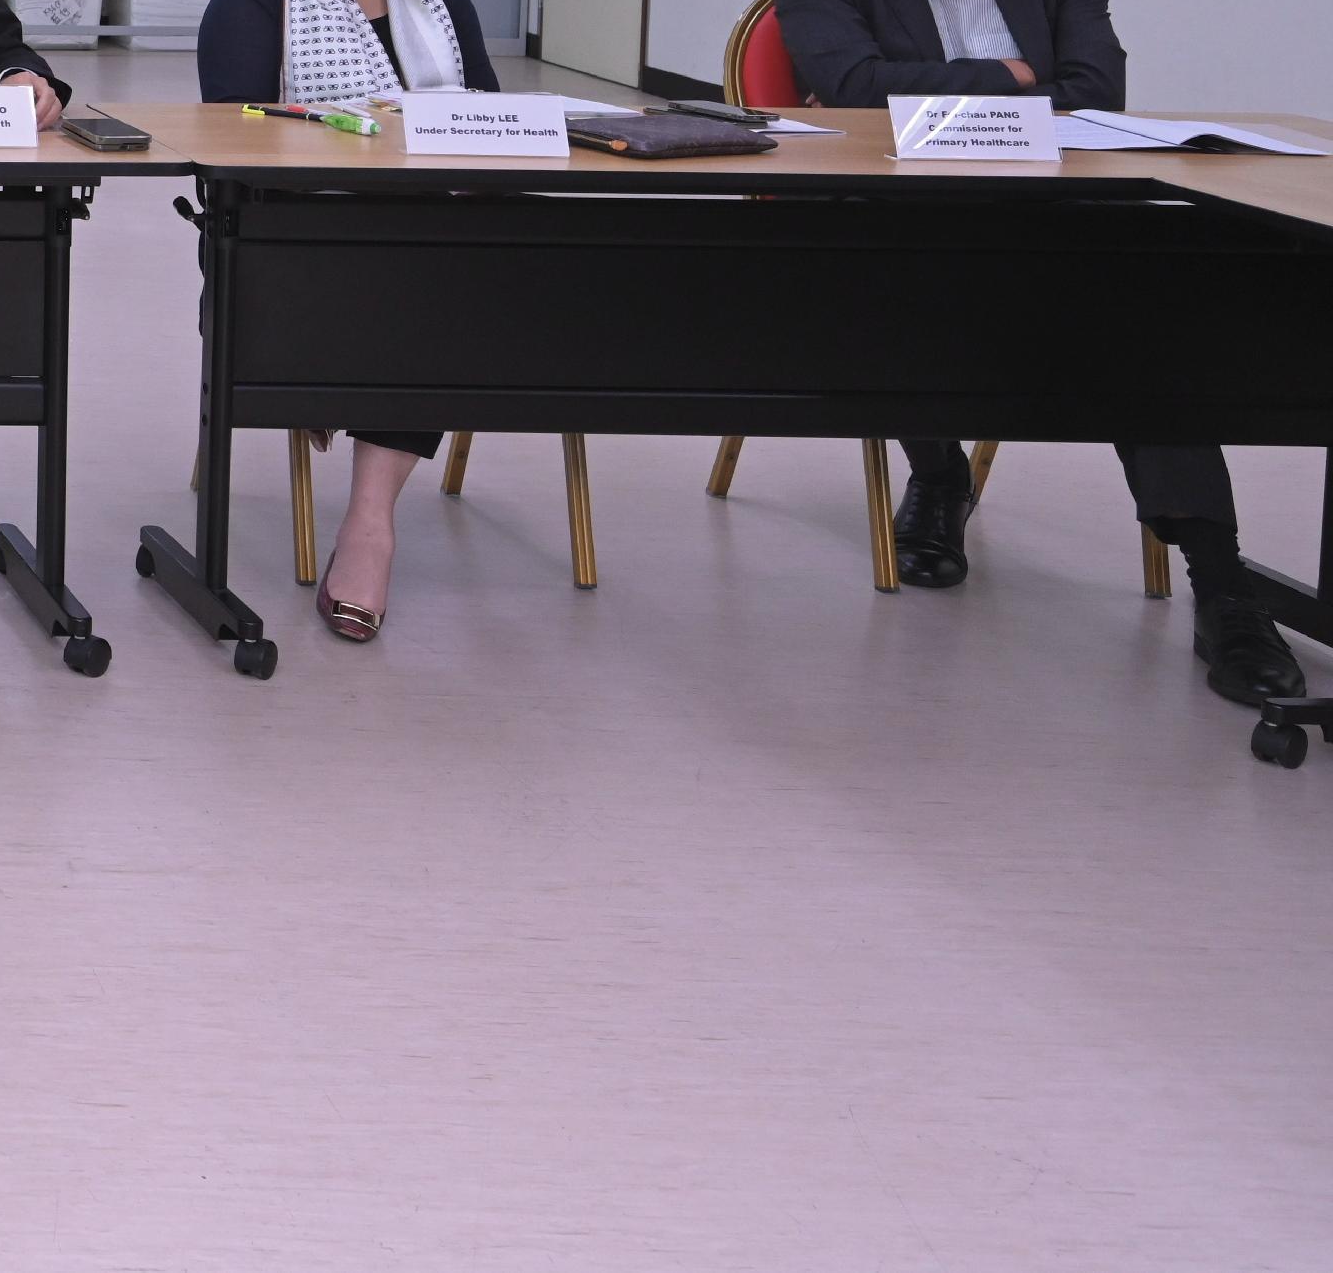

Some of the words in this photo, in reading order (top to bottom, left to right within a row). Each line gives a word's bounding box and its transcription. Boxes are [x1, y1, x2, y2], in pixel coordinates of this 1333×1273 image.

[451, 113, 464, 121] Dr
[466, 114, 495, 124] Libby
[498, 115, 519, 123] LEE
[926, 110, 938, 118] Dr
[990, 111, 1020, 119] PANG
[415, 127, 447, 135] Under
[450, 127, 502, 137] Secretary
[505, 128, 520, 136] for
[523, 128, 559, 137] Health
[1007, 125, 1023, 133] for
[971, 139, 1030, 148] Healthcare
